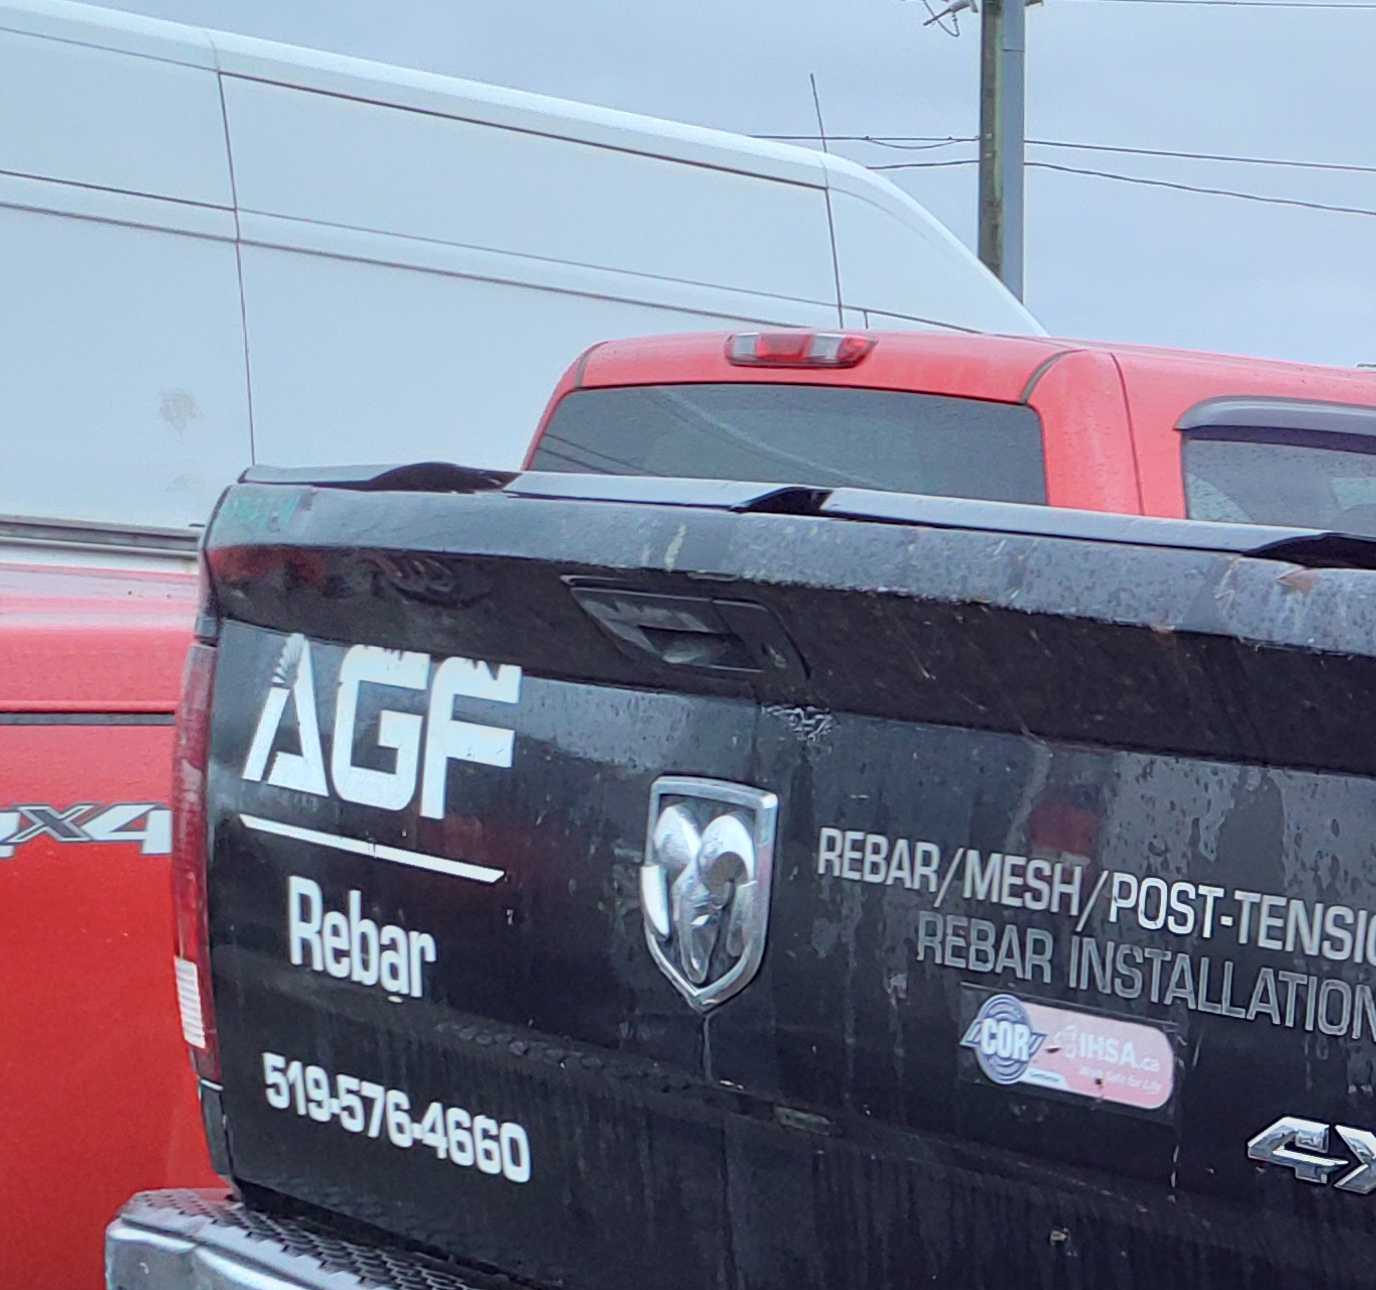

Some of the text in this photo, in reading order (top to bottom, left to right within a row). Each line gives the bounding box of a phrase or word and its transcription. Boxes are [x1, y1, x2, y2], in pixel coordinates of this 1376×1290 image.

[242, 633, 522, 819] AGF
[0, 803, 173, 859] X4
[287, 875, 437, 999] Rebar
[916, 910, 1054, 984] REBAR
[979, 1017, 1031, 1062] COR
[261, 1051, 532, 1183] 519-576-4660
